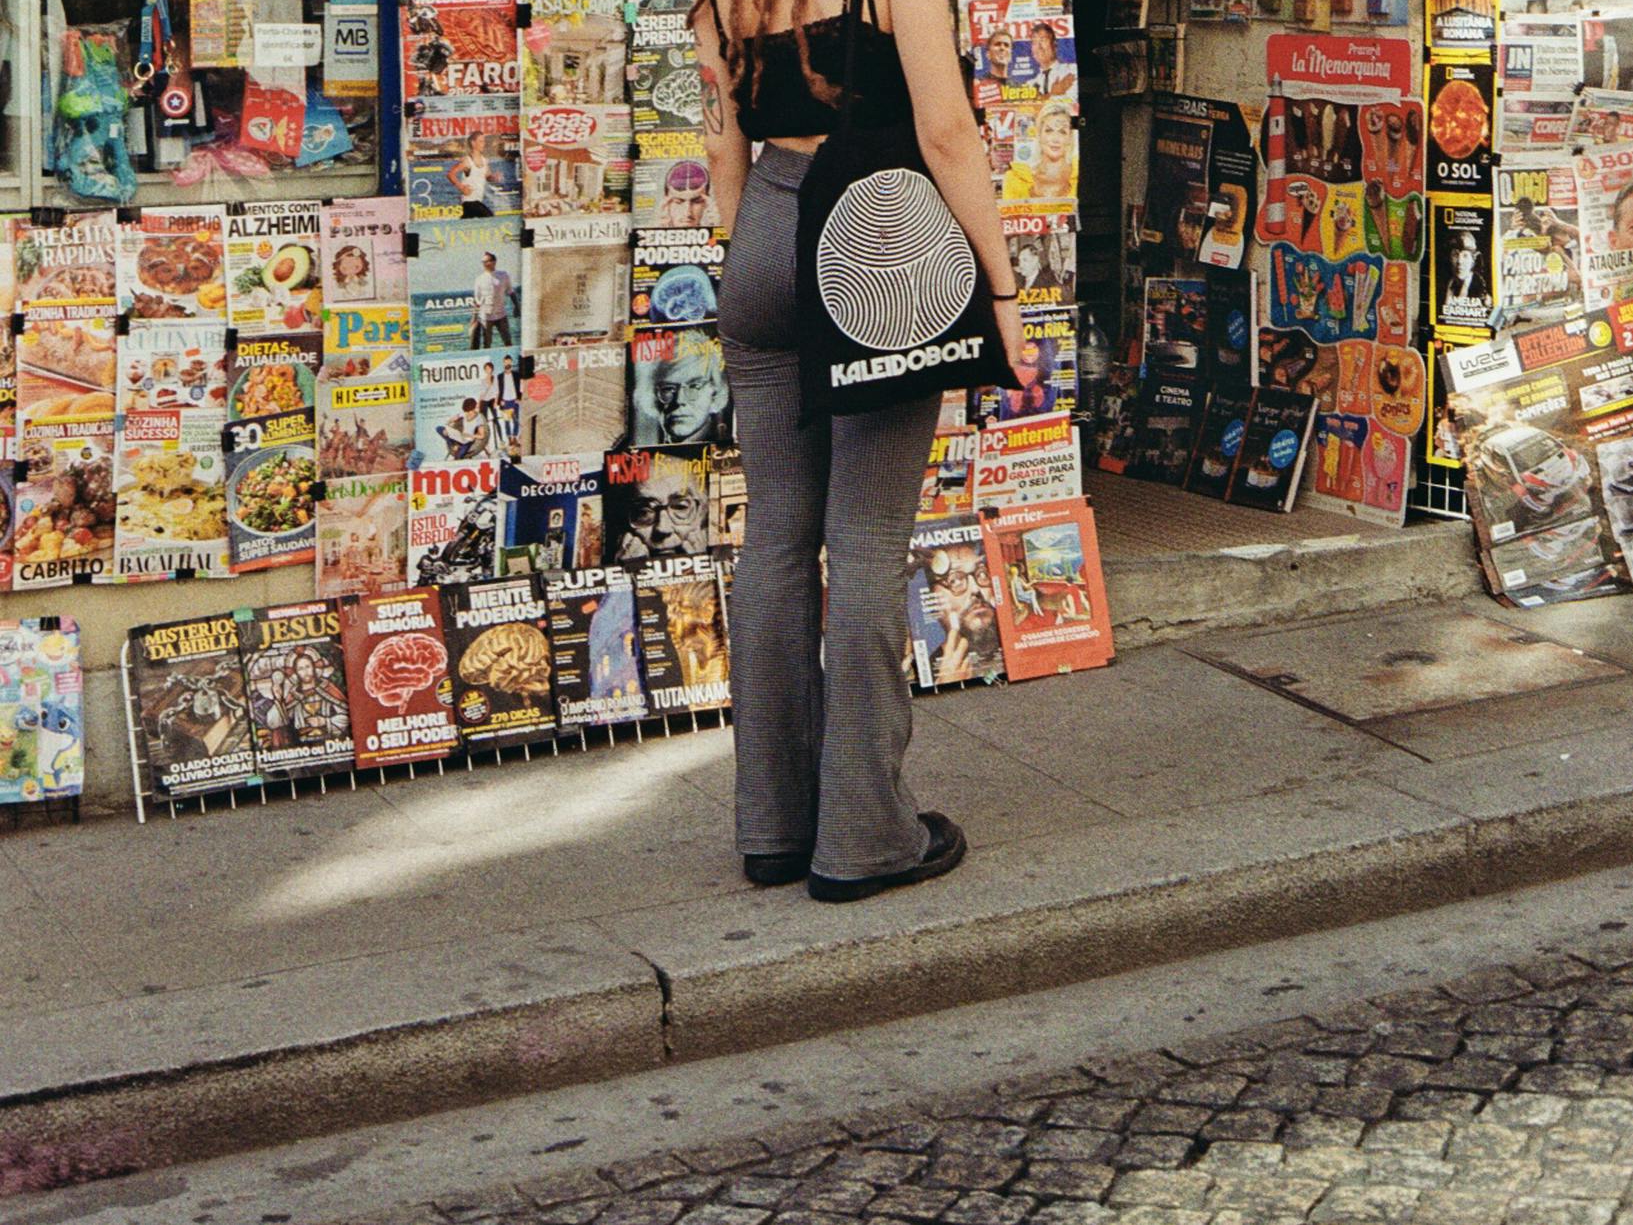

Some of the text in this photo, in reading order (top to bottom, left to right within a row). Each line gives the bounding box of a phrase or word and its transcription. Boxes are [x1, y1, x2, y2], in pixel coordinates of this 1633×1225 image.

[335, 29, 370, 47] MB
[1306, 46, 1391, 80] Menorquina
[1507, 46, 1532, 69] JN
[450, 62, 520, 87] FARO
[1438, 163, 1481, 179] O SOL
[411, 177, 433, 208] 3
[411, 203, 464, 219] Treinos
[228, 215, 320, 239] ALZHEIM
[637, 228, 710, 247] CEREBRO
[633, 244, 725, 265] PODEROSO
[425, 295, 493, 310] ALGARVE
[238, 341, 289, 356] DIETAS
[235, 352, 318, 368] ATUALIDADE
[830, 337, 984, 388] KALEIDOBOLT
[420, 363, 479, 384] human
[1160, 385, 1190, 398] CINEMA
[1163, 395, 1193, 408] TEATRO
[126, 416, 178, 429] COZINHA
[266, 414, 306, 431] SUPER
[126, 428, 179, 440] SUCESSO
[233, 423, 262, 453] 30
[1008, 420, 1070, 449] internet
[607, 449, 650, 485] VISÃO
[1012, 453, 1075, 471] PROGRAMAS
[412, 462, 499, 496] mot
[979, 466, 1008, 487] 20
[1048, 463, 1075, 476] PARA
[1019, 474, 1065, 489] O SEU PC
[521, 478, 598, 497] DECORAÇÃO
[411, 514, 447, 533] ESTILO
[240, 537, 275, 551] PRATOS
[410, 527, 457, 548] REBELDE
[119, 552, 213, 574] BACALHAU
[240, 547, 268, 562] SUPER
[20, 557, 104, 581] CABRITO
[637, 554, 714, 579] SUPE
[470, 587, 532, 610] MENTE
[378, 602, 423, 619] SUPER
[457, 601, 546, 628] PODEROSA
[259, 612, 341, 648] JESUS
[150, 644, 178, 661] DA
[377, 711, 448, 734] MELHORE
[512, 707, 541, 720] DICAS
[367, 736, 378, 751] O
[381, 732, 408, 749] SEU
[171, 751, 253, 774] O LADO OCULTO
[257, 744, 310, 763] Humano
[311, 745, 325, 756] ou
[162, 773, 182, 786] DO
[182, 768, 212, 783] LIVRO
